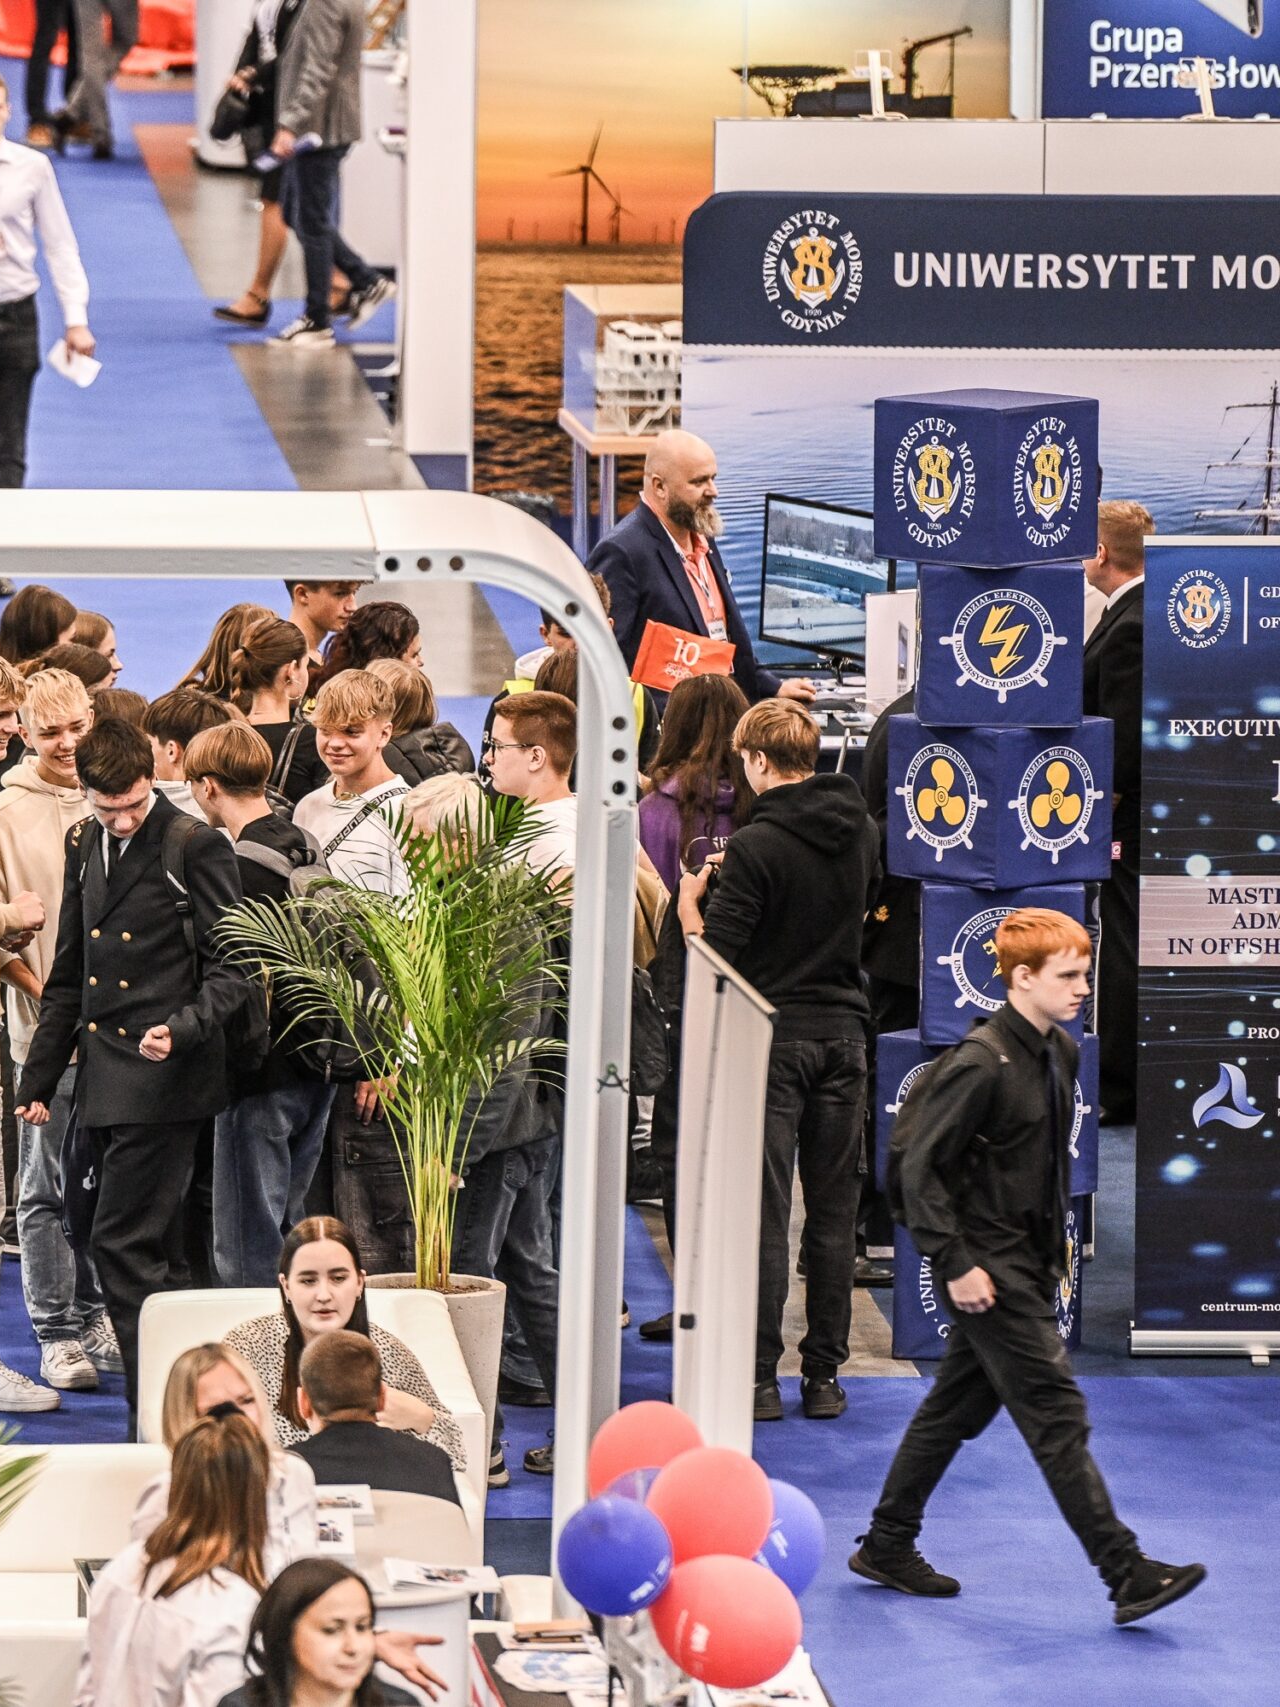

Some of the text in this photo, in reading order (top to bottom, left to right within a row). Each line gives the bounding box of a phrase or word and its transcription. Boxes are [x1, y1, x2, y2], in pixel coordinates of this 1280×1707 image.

[1089, 19, 1184, 61] Grupa
[763, 209, 841, 303] UNIWERSYTET
[839, 230, 864, 304] MORSKI
[893, 251, 1196, 290] UNIWERSYTET
[780, 309, 847, 333] GDYNIA
[892, 416, 957, 513] UNIWERSYTET
[956, 440, 976, 519] MORSKI
[1013, 416, 1067, 519] UNIWERSYTET
[1065, 435, 1082, 513] MORSKI
[907, 522, 962, 549] GDYNIA
[1025, 523, 1071, 548] GDYNIA
[993, 591, 1051, 627] ELEKTRYCZNY
[1166, 569, 1232, 636] GDYNIA MARITIME UNIVERSITY
[673, 637, 701, 667] 10
[1180, 635, 1219, 649] POLAND
[954, 639, 997, 687] UNIWERSYTET
[998, 672, 1034, 688] MORSKI
[1038, 639, 1053, 668] GDYNI
[1167, 719, 1280, 737] EXECUTI
[932, 746, 976, 788] MECHANICZNY
[1048, 749, 1093, 782] MECHANICZNY
[906, 791, 936, 846] UNIWERSYTET
[936, 833, 963, 847] MORSKI
[1019, 801, 1052, 849] UNIWERSYTET
[1051, 831, 1080, 850] MORSKI
[977, 920, 1000, 939] NAUK
[1167, 938, 1194, 955] IN
[953, 959, 999, 1010] UNIWERSYTET
[1247, 1026, 1280, 1040] PRO
[1200, 1301, 1280, 1312] centrum-mo
